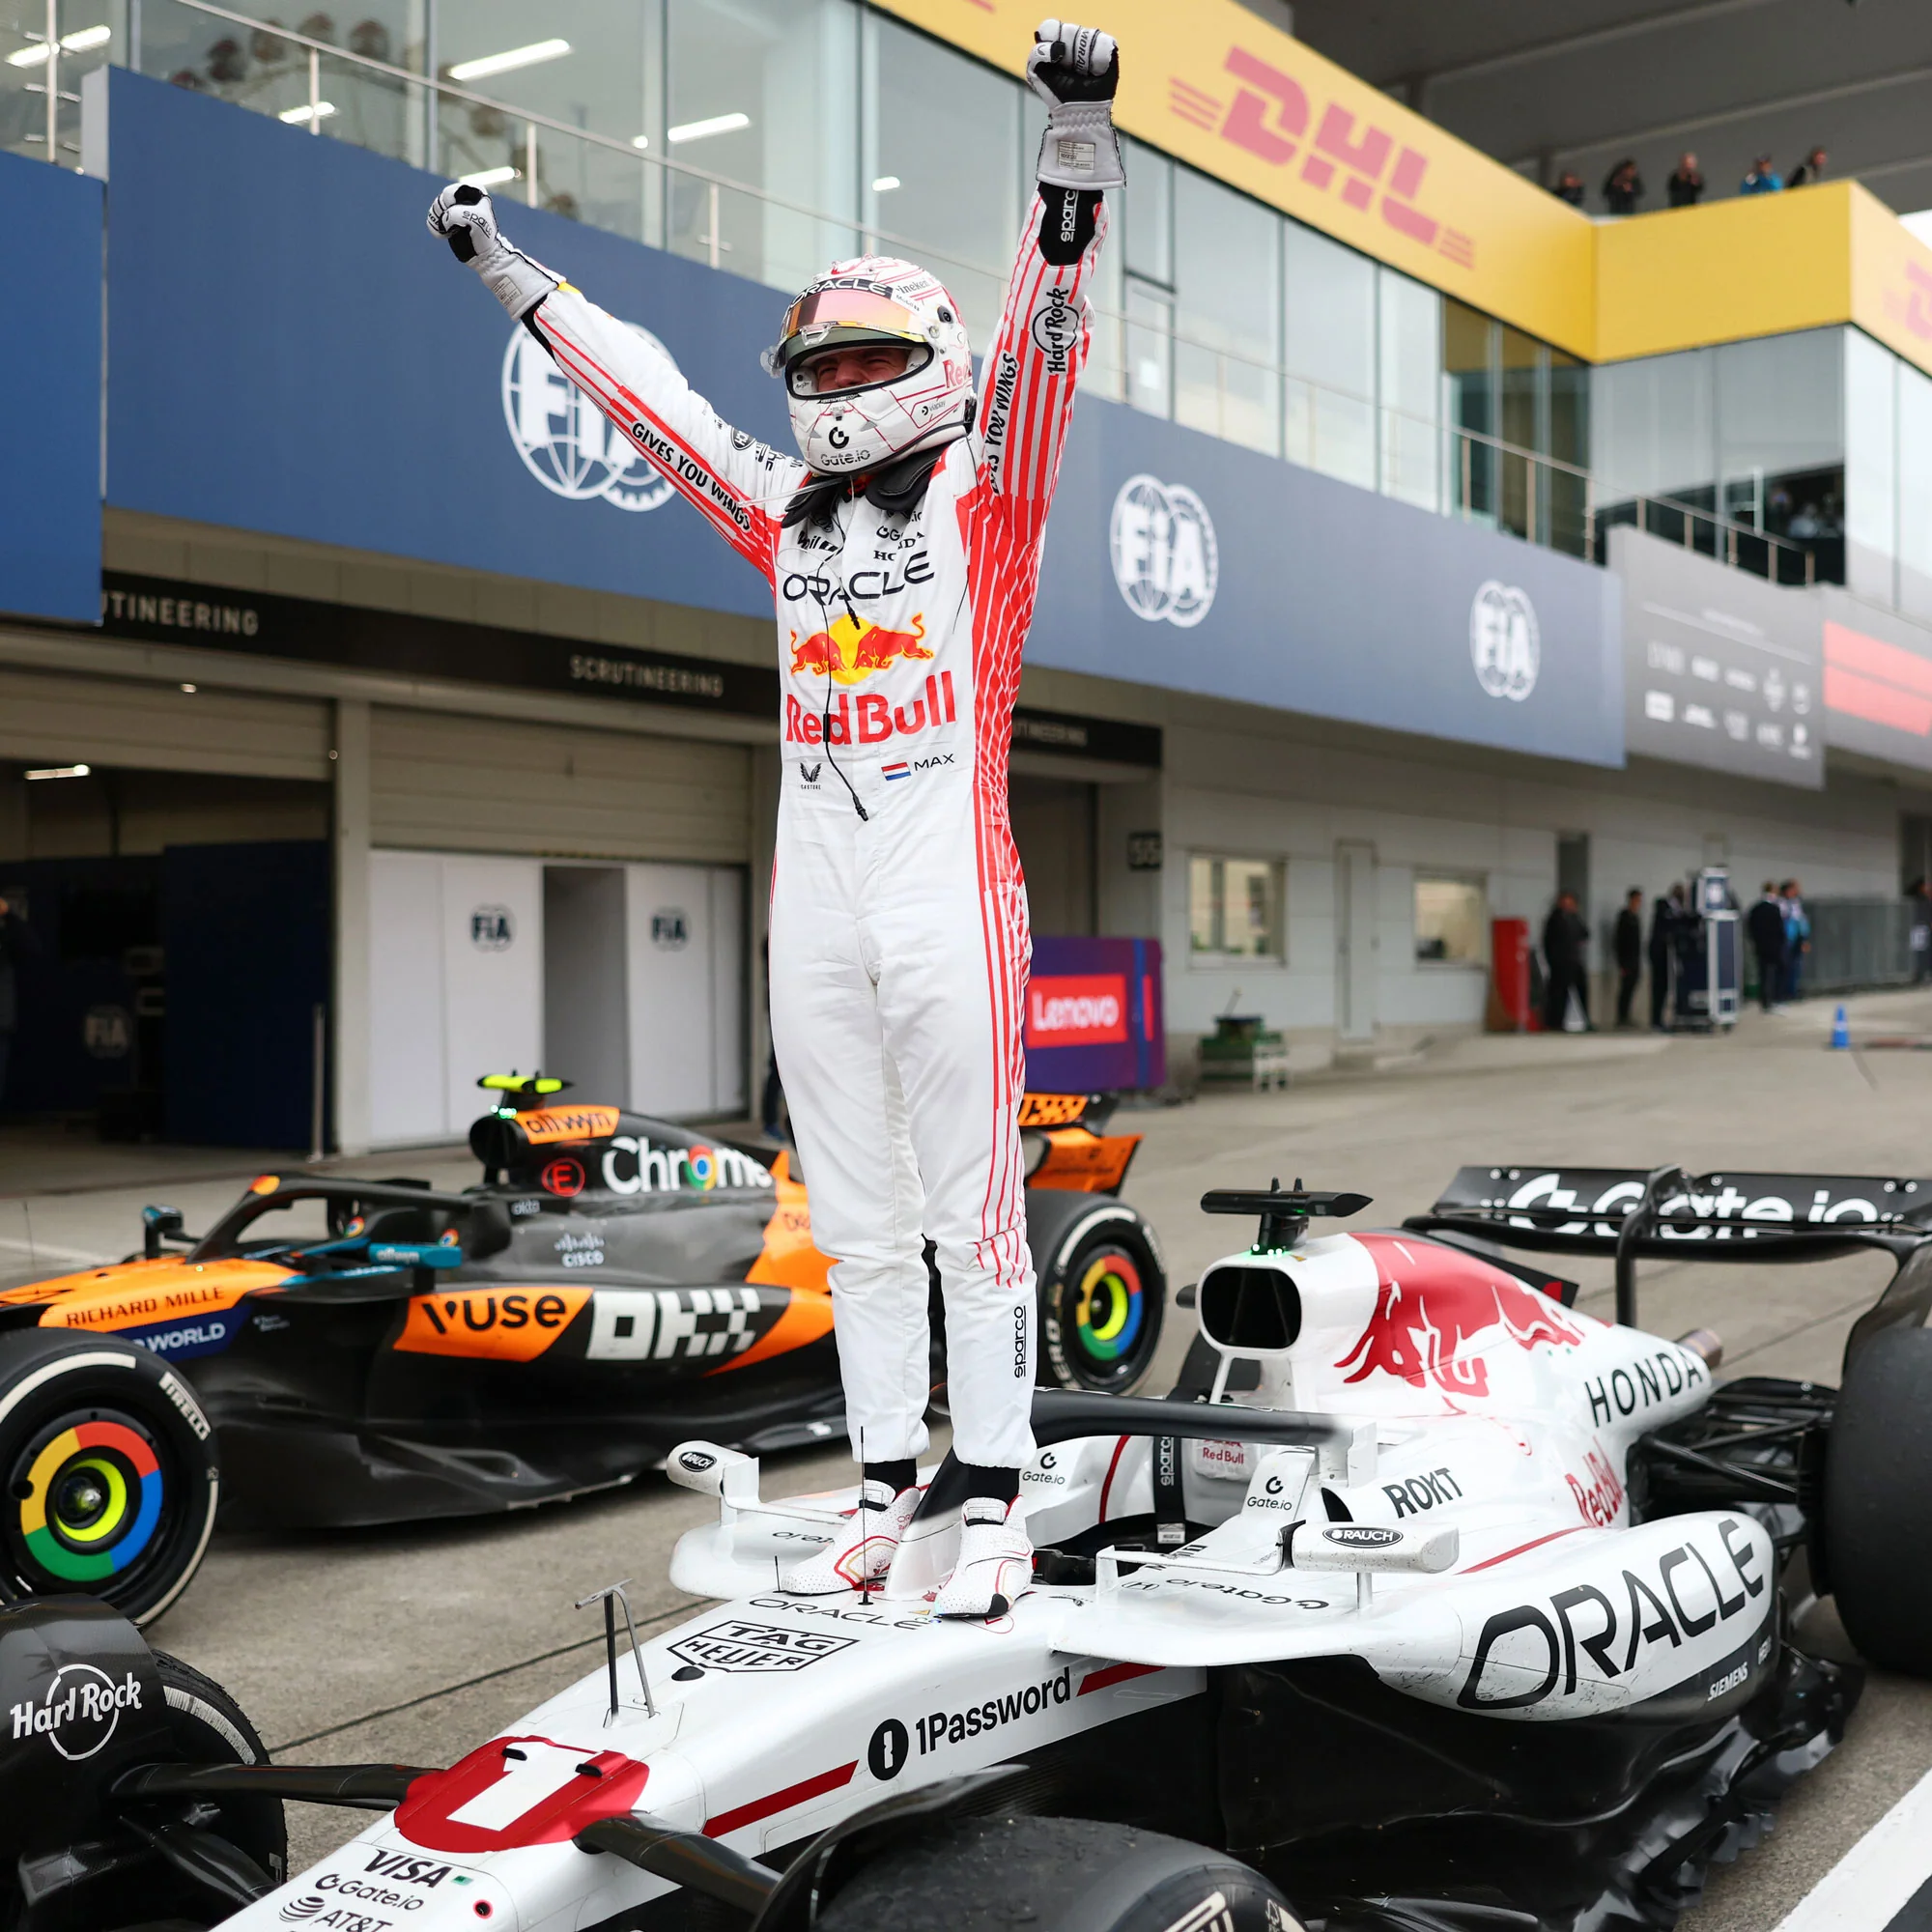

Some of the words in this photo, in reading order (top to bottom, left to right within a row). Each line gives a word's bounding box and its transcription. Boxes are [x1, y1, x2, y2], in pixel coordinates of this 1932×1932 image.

[1219, 45, 1440, 247] DHL
[1061, 189, 1079, 242] sparc
[790, 277, 887, 309] ORACLE
[1046, 288, 1069, 333] Rock
[1049, 332, 1065, 374] Hard
[998, 354, 1017, 412] WINGS
[632, 422, 675, 463] GIVES
[676, 455, 709, 488] YOU
[711, 482, 751, 531] WINGS
[821, 450, 870, 466] Gate.io
[1120, 502, 1208, 600] FIA
[782, 551, 935, 606] ORACLE
[1474, 602, 1534, 678] FIA
[570, 654, 724, 697] SCRUTINEERING
[785, 694, 852, 745] Red
[856, 670, 956, 744] Bull
[914, 753, 954, 772] MAX
[1032, 990, 1120, 1032] Lenovo
[526, 1109, 612, 1137] allwyn
[602, 1136, 773, 1195] Chrome
[562, 1250, 605, 1268] cisco
[67, 1299, 157, 1327] RICHARD
[165, 1287, 225, 1309] MILLE
[146, 1322, 226, 1352] WORLD
[1014, 1305, 1027, 1379] sparco
[1585, 1351, 1704, 1428] HONDA
[1160, 1436, 1174, 1486] sparc
[1203, 1447, 1223, 1462] Red
[1224, 1450, 1245, 1464] Bull
[1022, 1470, 1065, 1486] Gate.io
[1246, 1495, 1293, 1512] Gate.io
[1342, 1528, 1395, 1543] RAUCH
[749, 1598, 931, 1632] ORACLE
[1457, 1519, 1766, 1710] ORACLE
[682, 1640, 810, 1667] HEUER
[730, 1626, 839, 1651] TAG
[1707, 1662, 1748, 1702] SIEMENS
[11, 1686, 76, 1739] Hard
[79, 1672, 143, 1721] Rock
[915, 1667, 1072, 1757] 1Password
[363, 1849, 454, 1889] VISA
[338, 1880, 424, 1911] Gate.io
[315, 1910, 394, 1932] AT&T
